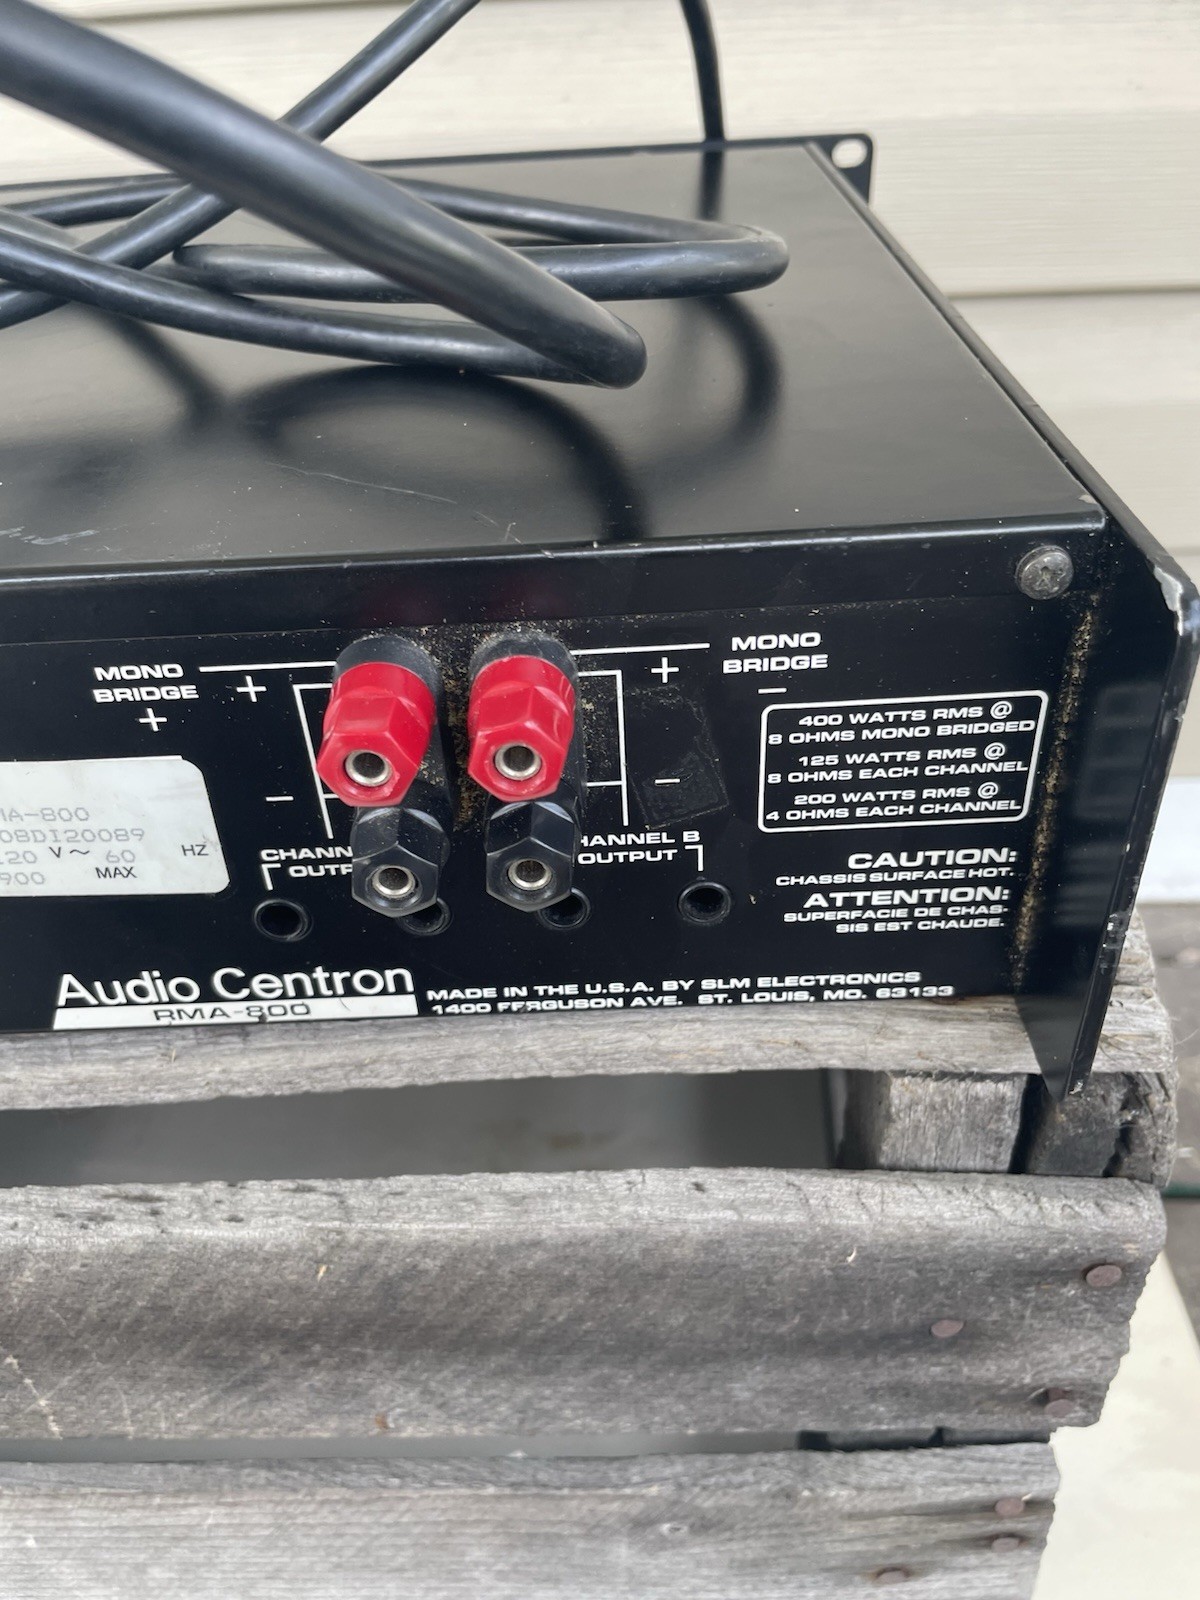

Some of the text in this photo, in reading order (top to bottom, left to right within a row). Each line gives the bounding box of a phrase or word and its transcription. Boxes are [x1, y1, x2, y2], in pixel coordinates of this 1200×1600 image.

[731, 632, 822, 651] MONO
[94, 663, 184, 681] MONO
[722, 654, 829, 674] BRIDGE
[92, 685, 199, 703] BRIDGE
[799, 701, 1013, 727] 400 WATTS RMS @
[768, 720, 1036, 745] 8 OHMS MONO BRIDGED
[798, 742, 1006, 767] 125 WATTS RMS @
[767, 761, 1029, 784] 8 OHMS EACH CHANNEL
[794, 782, 999, 806] 200 WATTS RMS @
[765, 800, 1022, 822] 4 OHMS EACH CHANNEL
[683, 830, 701, 842] B
[106, 849, 136, 864] 60
[181, 844, 209, 856] HZ
[260, 846, 353, 862] CHANN
[577, 849, 678, 865] OUTPUT
[848, 847, 1017, 870] CAUTION:
[95, 866, 137, 879] MAX
[288, 864, 353, 879] OUTP
[775, 867, 1014, 886] CHASSIS SURFACE HOT.
[803, 886, 1010, 908] ATTENTION:
[784, 904, 1008, 922] SUPERFACIE DE CHAS-
[836, 917, 1005, 934] SIS EST CHAUDE.
[57, 965, 414, 1007] Audio Centron
[426, 971, 921, 1001] MADE IN THE U.S.A. BY SLM ELECTRONICS
[431, 1003, 492, 1015] 1400
[630, 995, 683, 1007] AVE.
[698, 994, 733, 1005] ST.
[741, 991, 815, 1004] LOUIS,
[823, 988, 867, 1000] MO.
[876, 985, 954, 999] 63133
[154, 1003, 312, 1022] RMA-800
